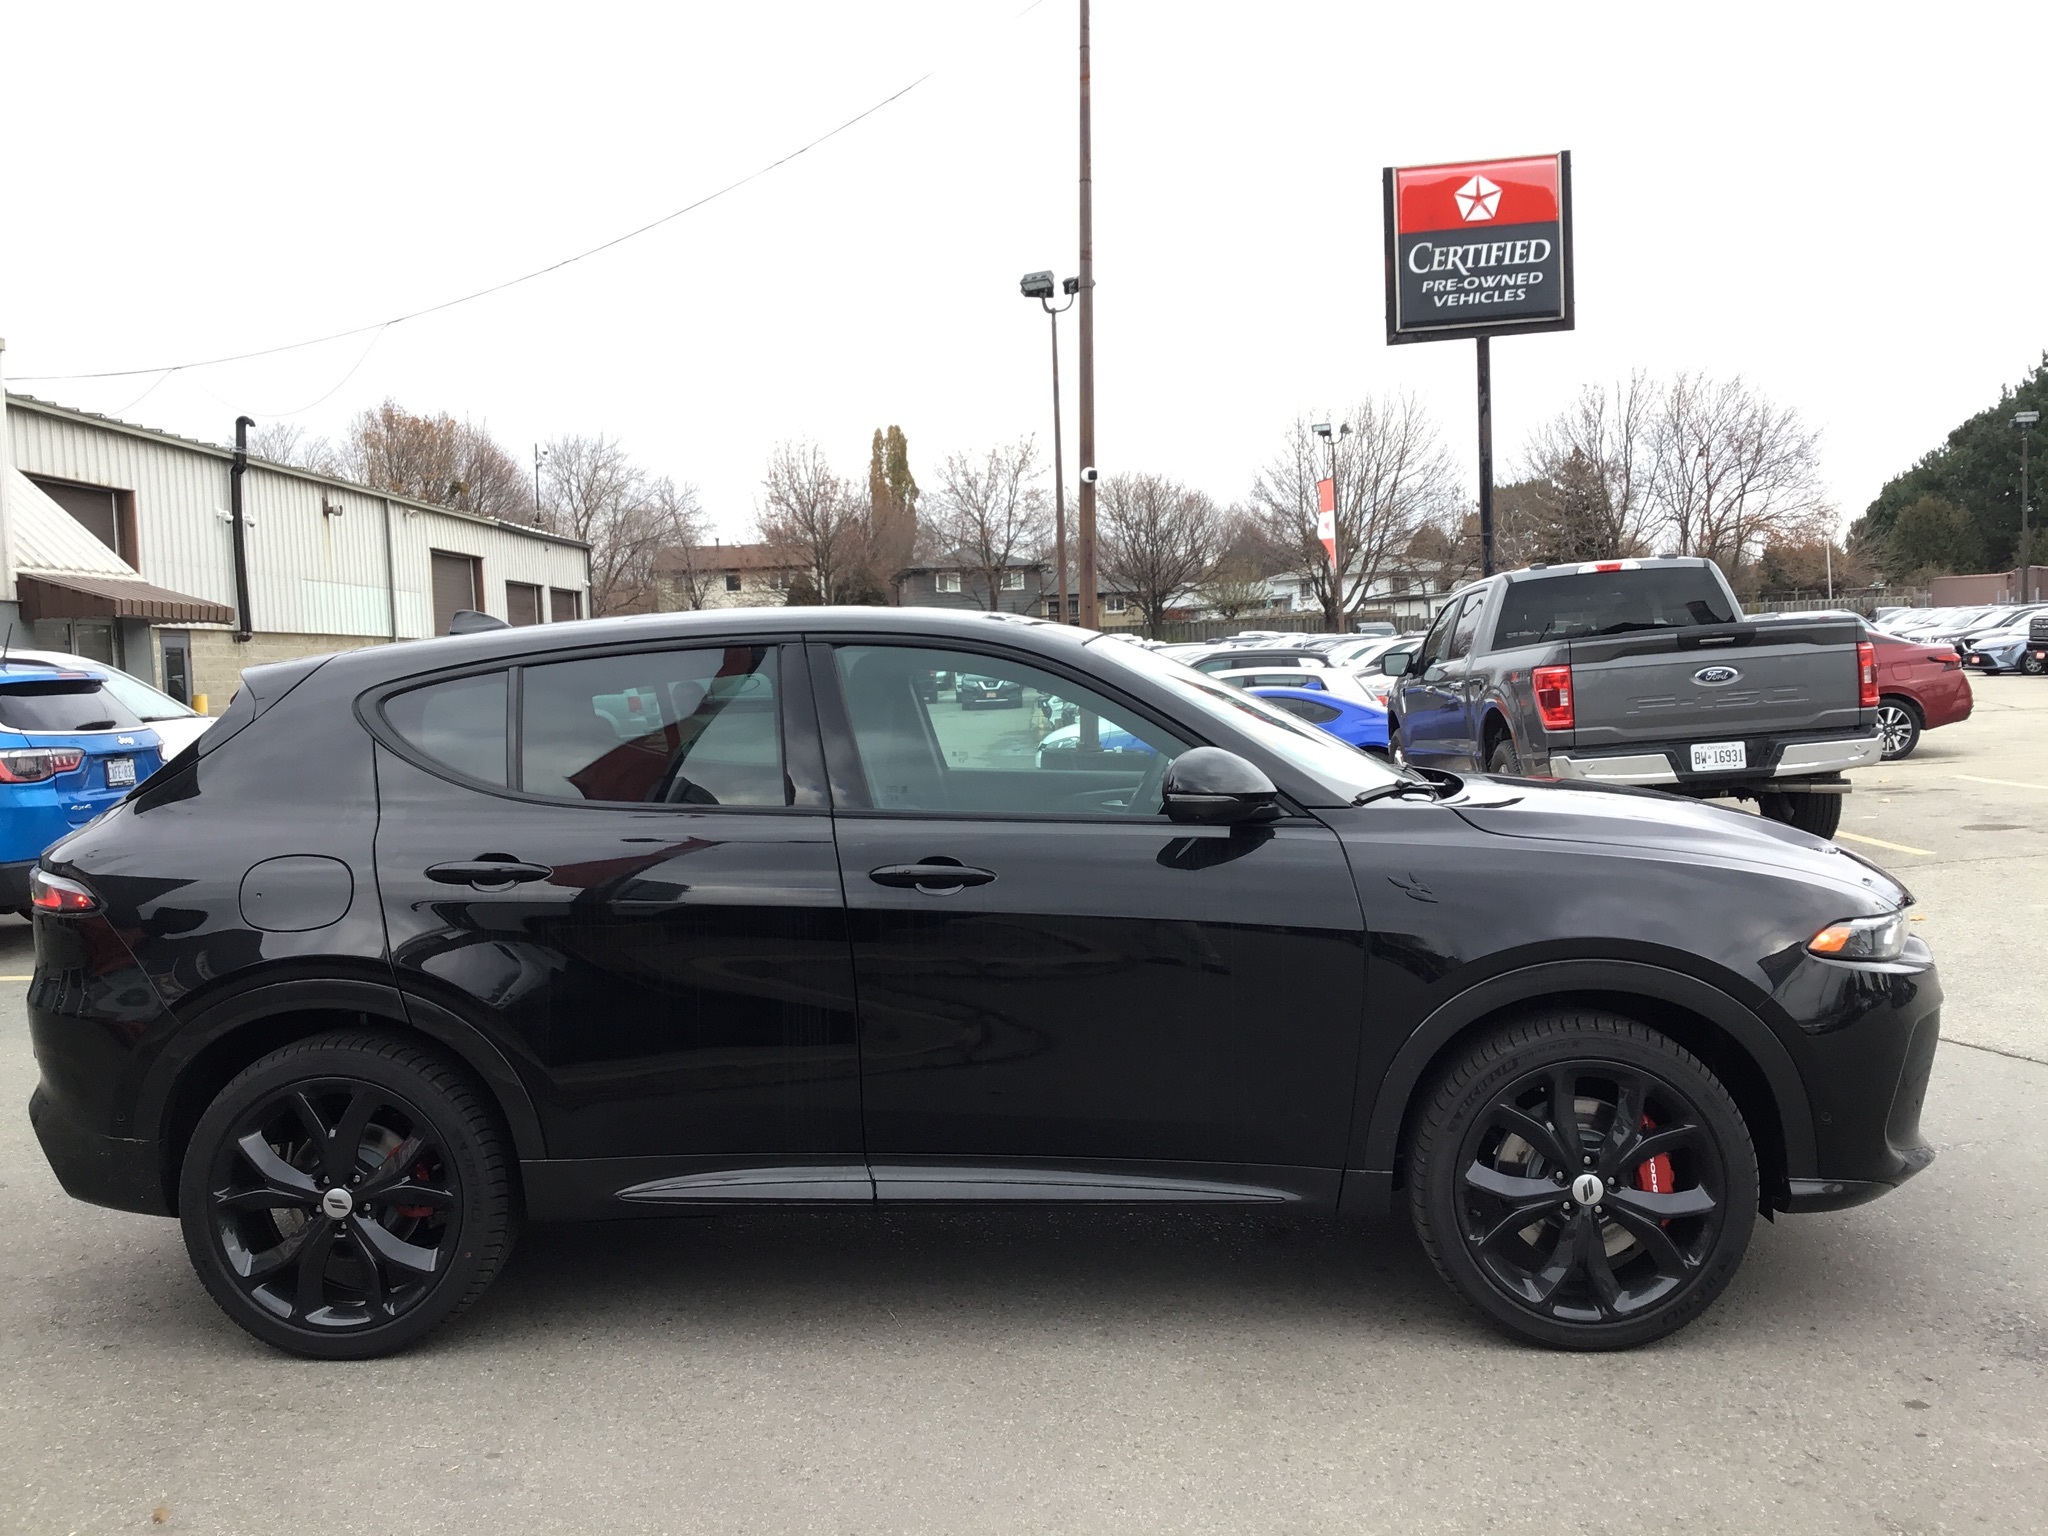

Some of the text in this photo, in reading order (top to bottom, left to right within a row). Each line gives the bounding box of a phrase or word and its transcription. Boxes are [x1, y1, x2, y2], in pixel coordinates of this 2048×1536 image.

[1408, 238, 1551, 276] CERTIFIED
[1422, 271, 1544, 293] PRE-OWNED
[1433, 288, 1526, 307] VEHICLES
[1705, 670, 1729, 681] Ford
[1713, 749, 1744, 764] 16931
[1649, 1156, 1659, 1194] ODG
